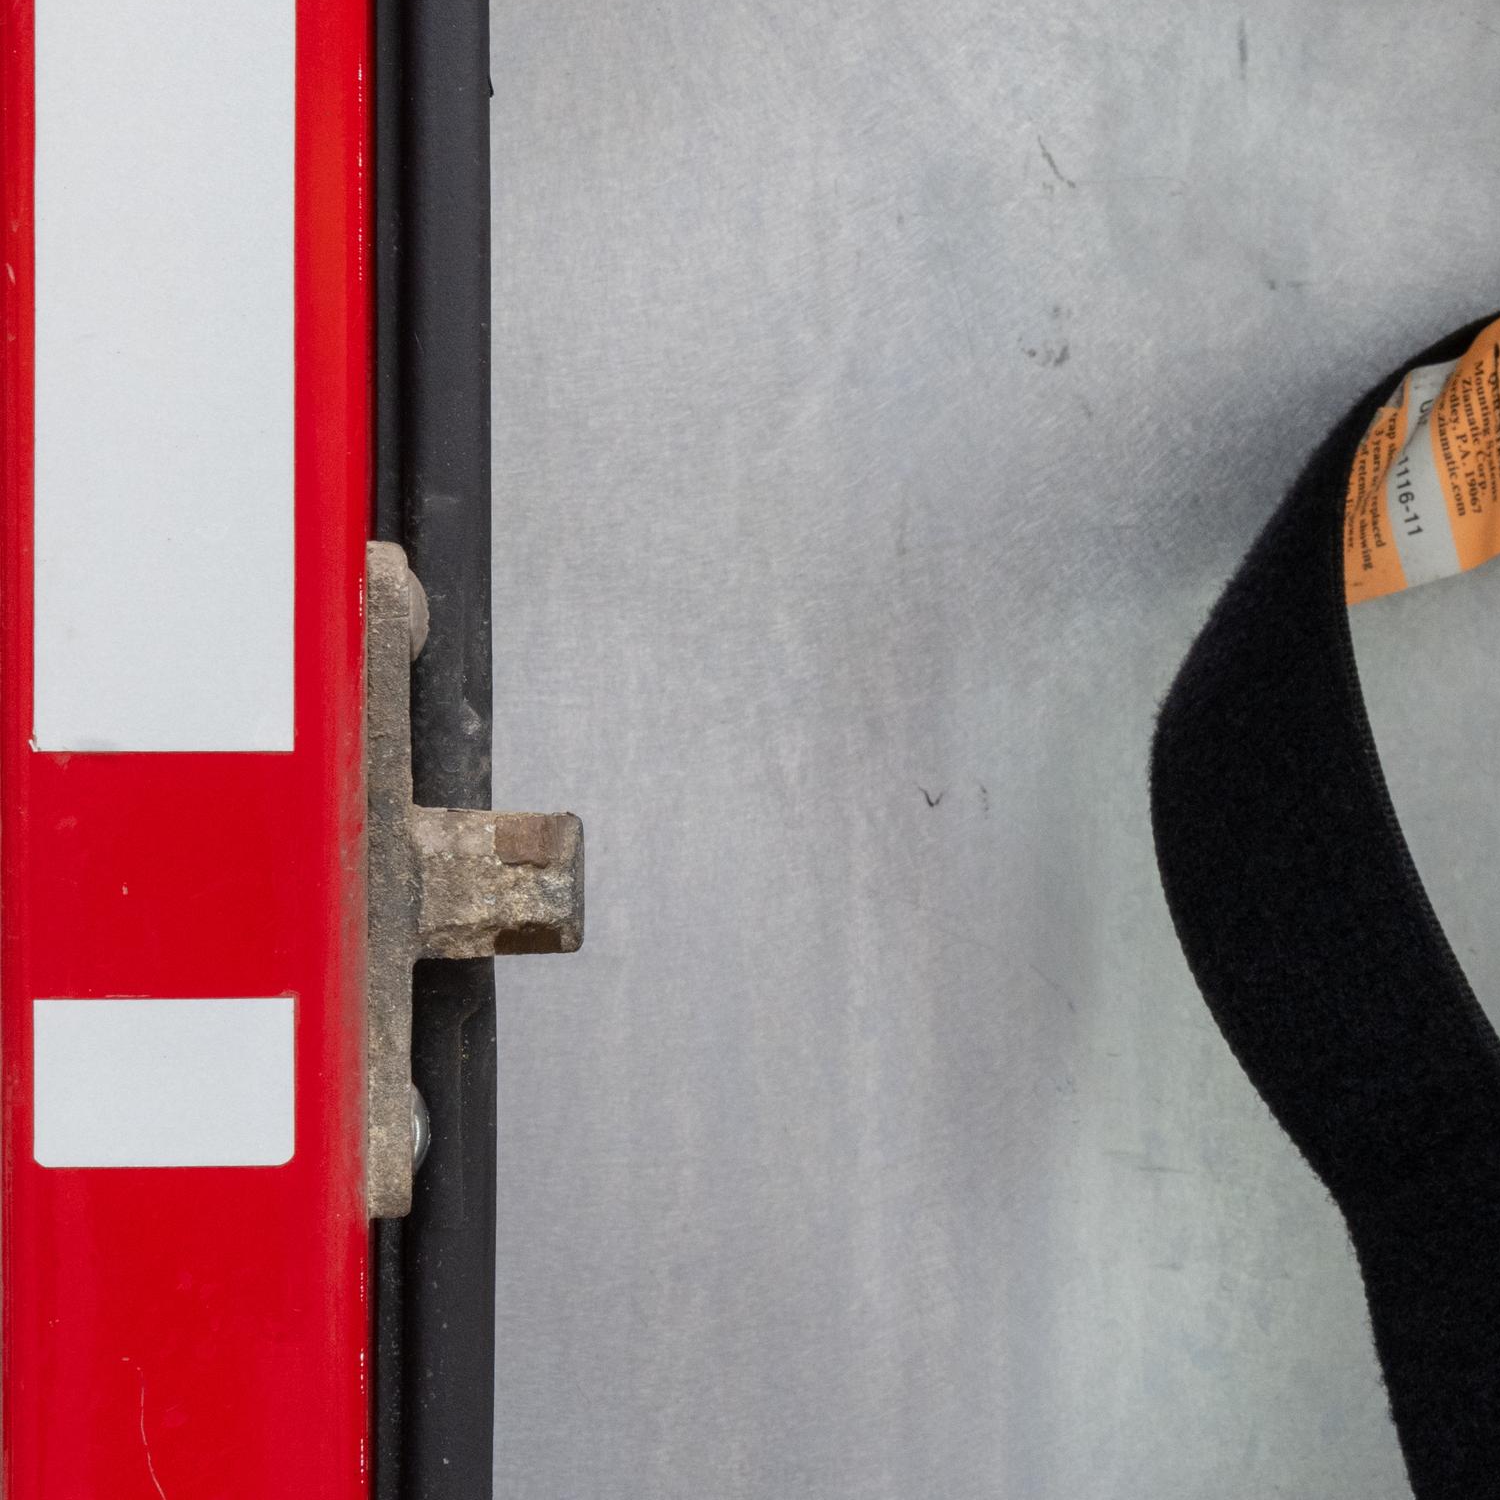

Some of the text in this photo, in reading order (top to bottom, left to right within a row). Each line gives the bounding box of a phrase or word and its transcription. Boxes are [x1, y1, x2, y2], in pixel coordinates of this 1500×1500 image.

[1371, 438, 1382, 473] years
[1461, 377, 1487, 496] Ziamatic Corp.
[1473, 360, 1498, 503] Mounting Systems
[1456, 433, 1471, 467] P.A.
[1464, 471, 1483, 514] 19067
[1370, 496, 1386, 548] replaced
